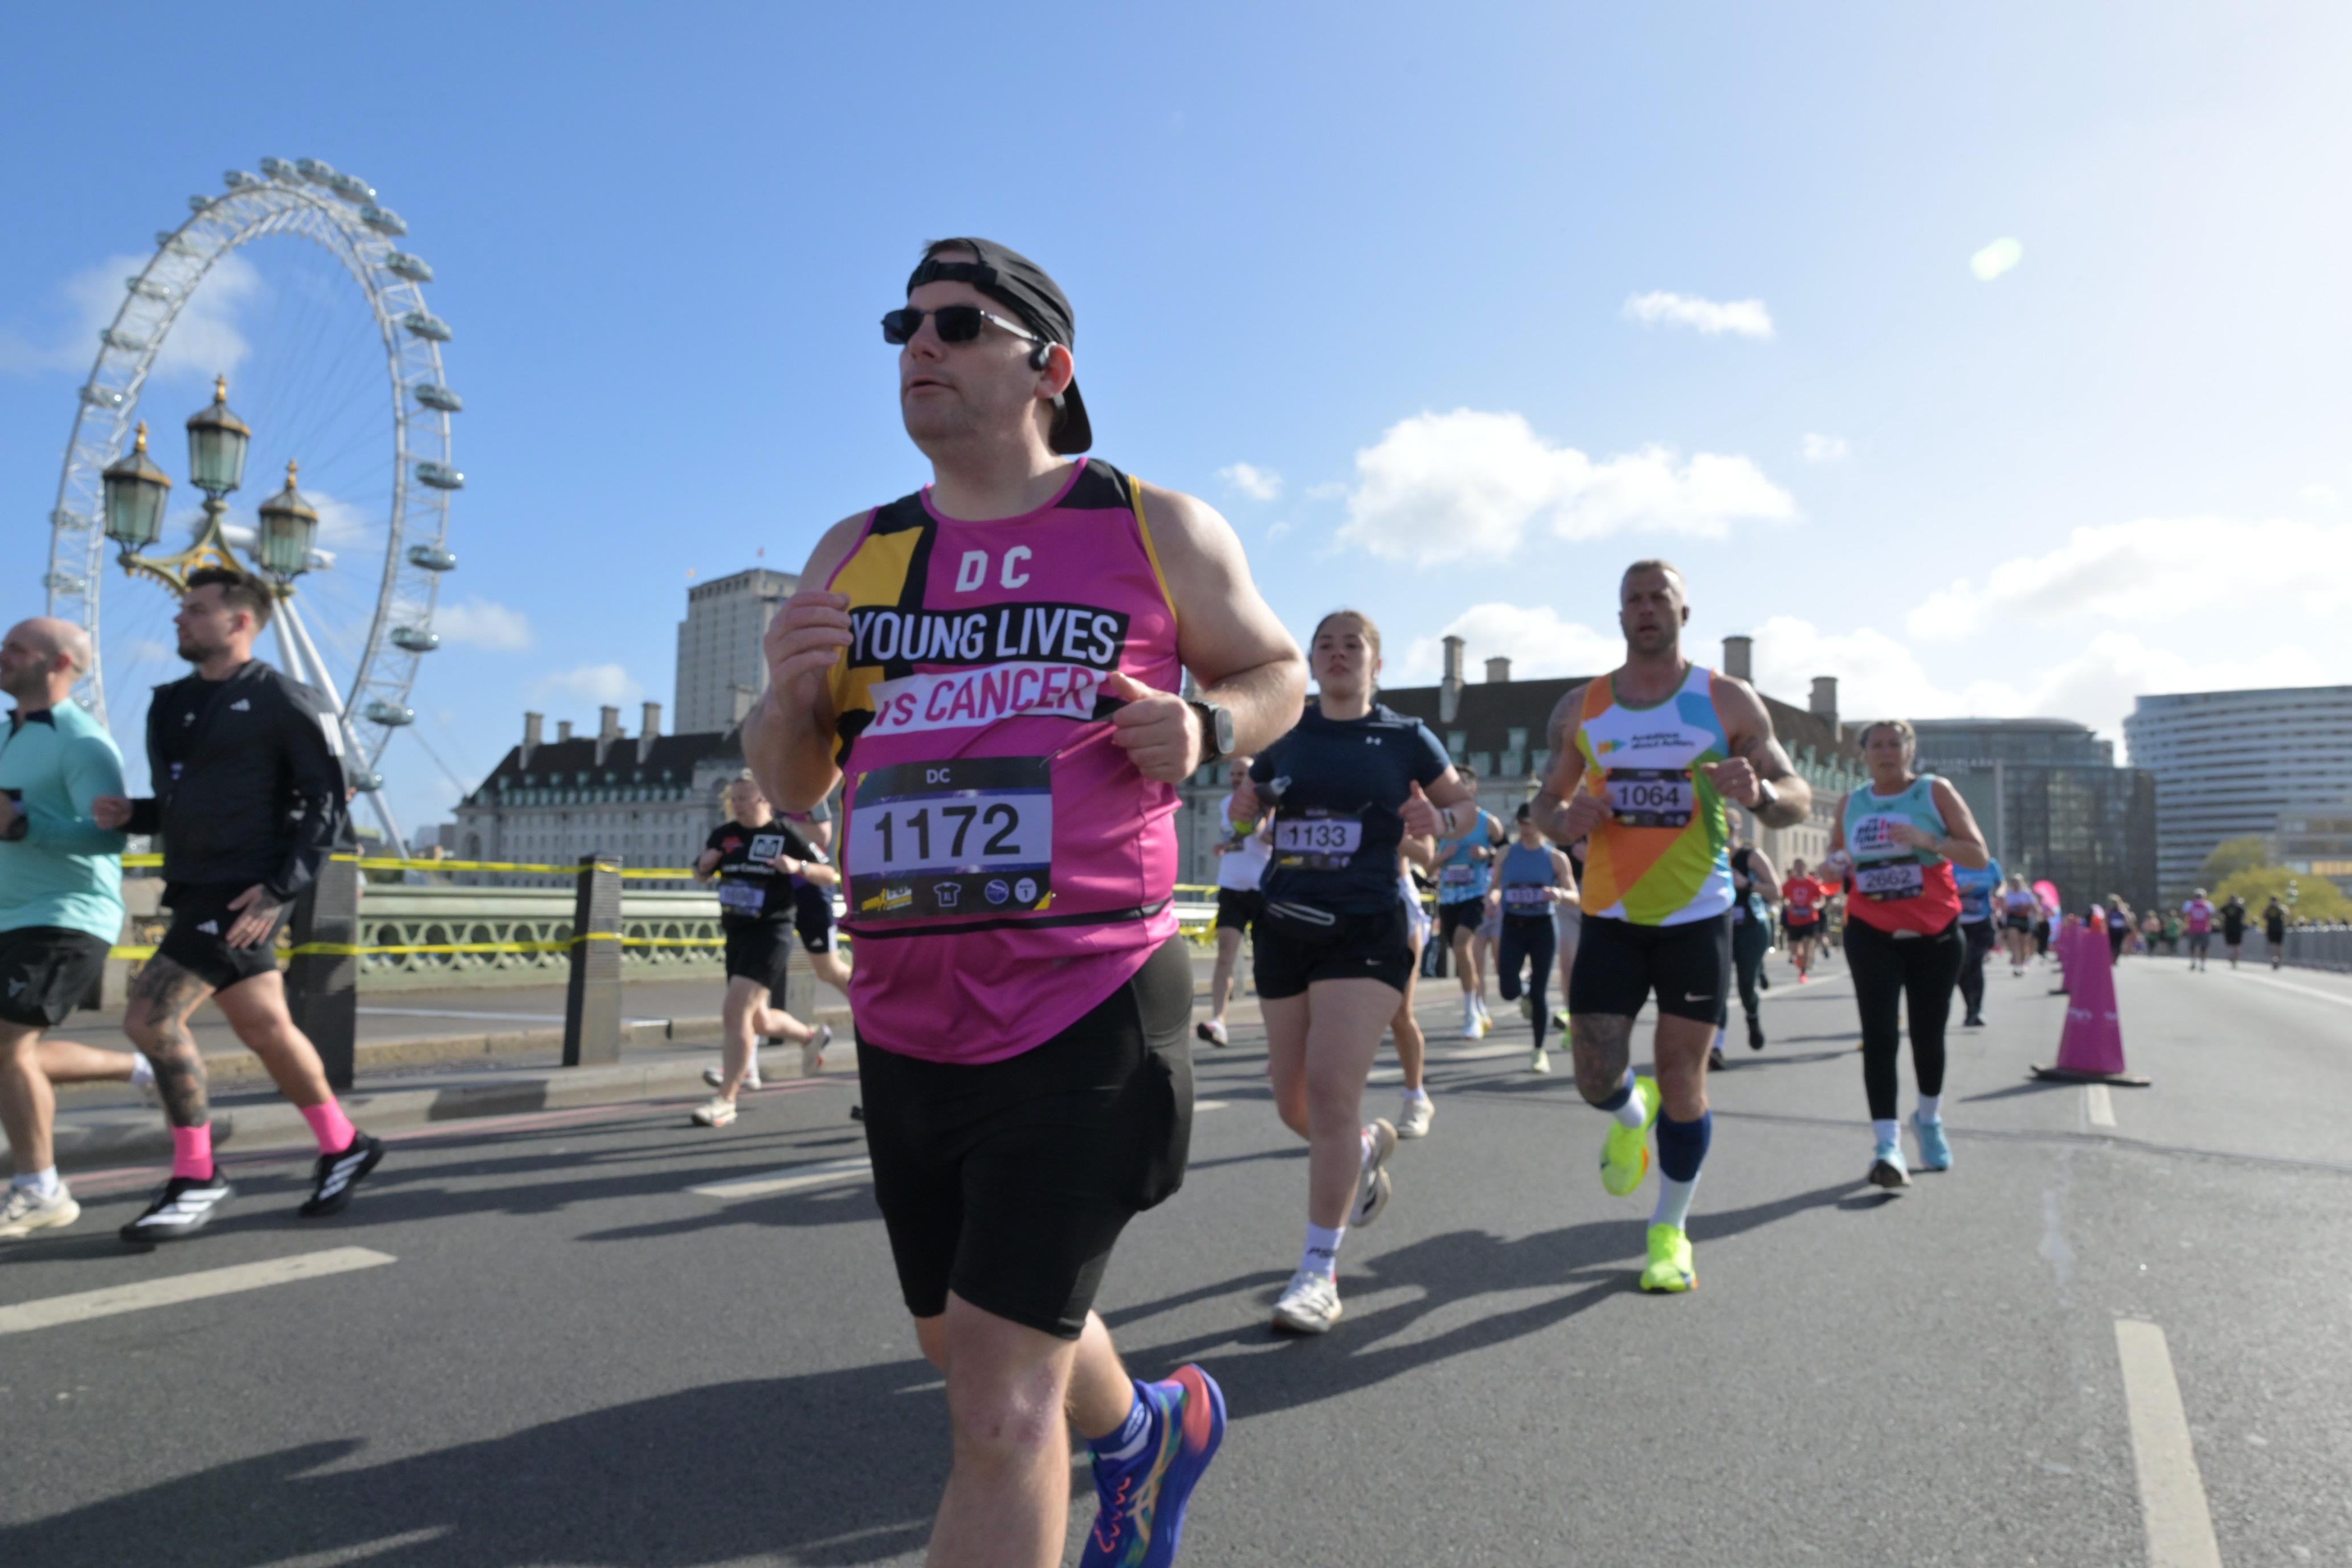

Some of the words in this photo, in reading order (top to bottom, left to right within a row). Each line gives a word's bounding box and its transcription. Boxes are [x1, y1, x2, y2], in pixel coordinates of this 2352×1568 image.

[852, 611, 987, 661] YOUNG
[995, 607, 1118, 665] LIVES
[924, 666, 1095, 722] CANCER
[926, 768, 951, 784] DC
[1619, 785, 1680, 806] 1064
[875, 803, 1020, 863] 1172
[1288, 825, 1346, 847] 1133
